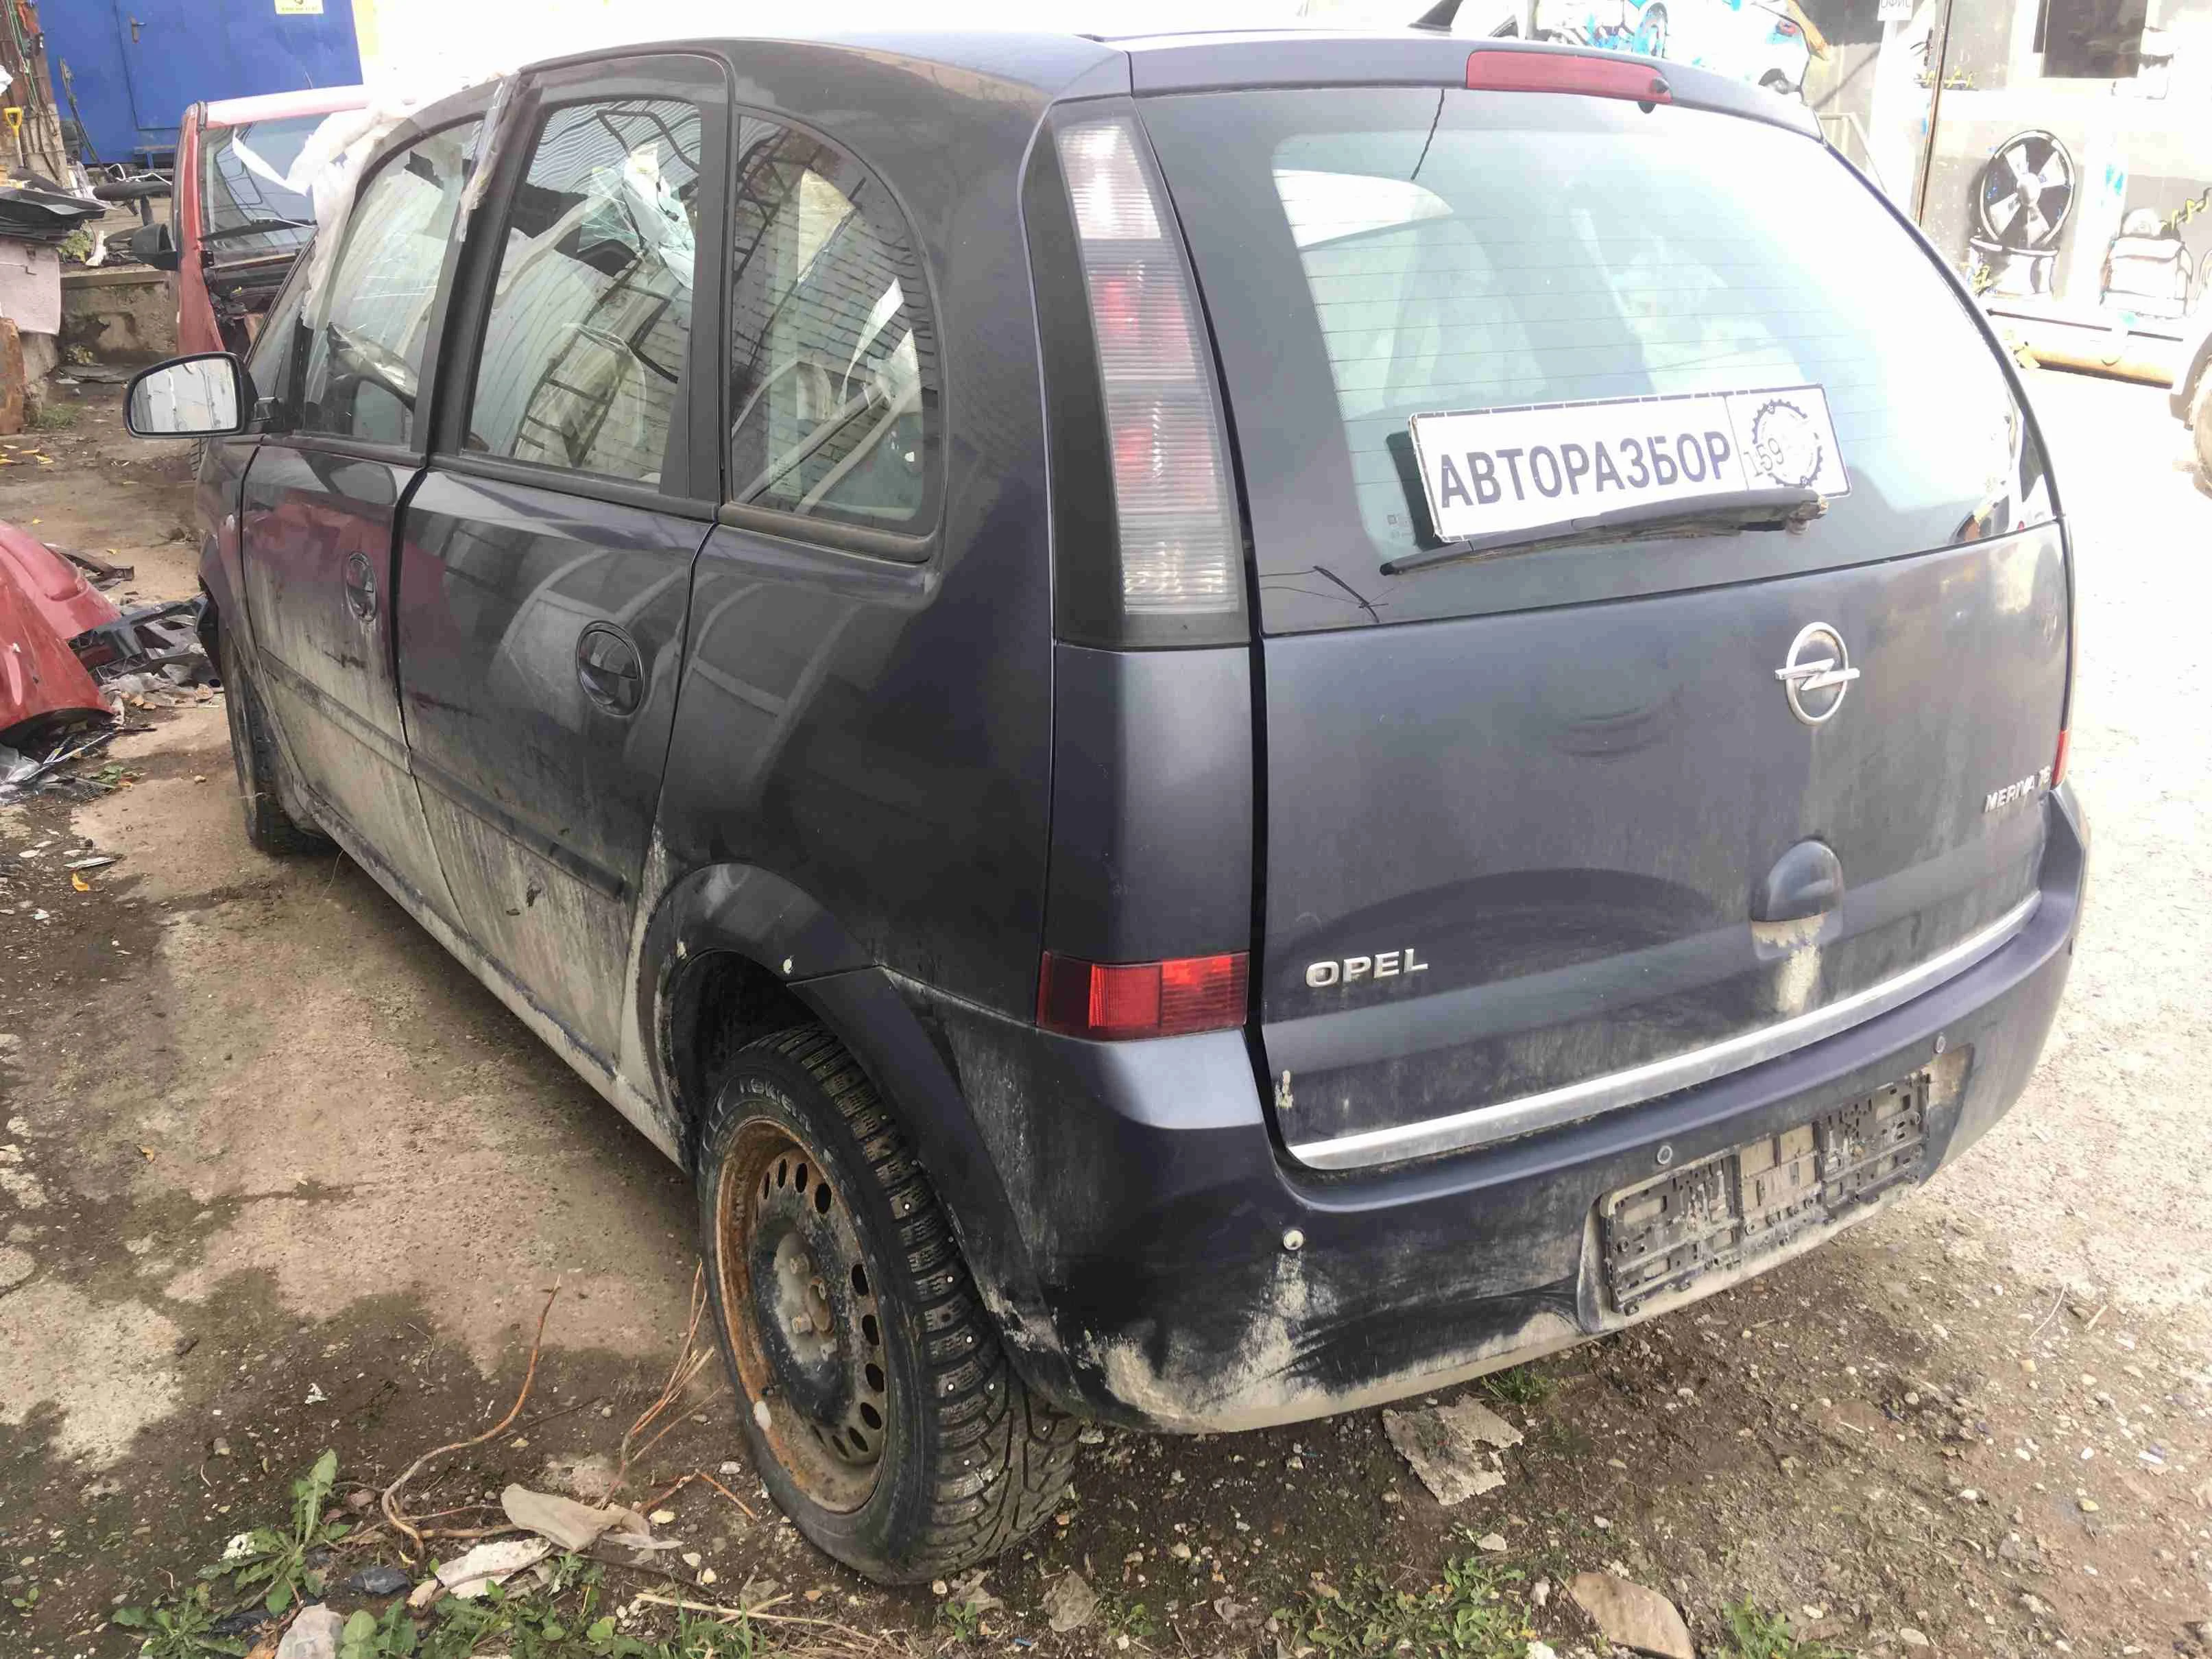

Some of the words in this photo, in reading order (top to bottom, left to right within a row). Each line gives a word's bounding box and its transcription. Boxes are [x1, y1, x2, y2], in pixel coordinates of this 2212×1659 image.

[1441, 431, 1731, 508] АВТОРАЗБОР
[1744, 438, 1784, 477] 159
[1306, 948, 1429, 988] OPEL
